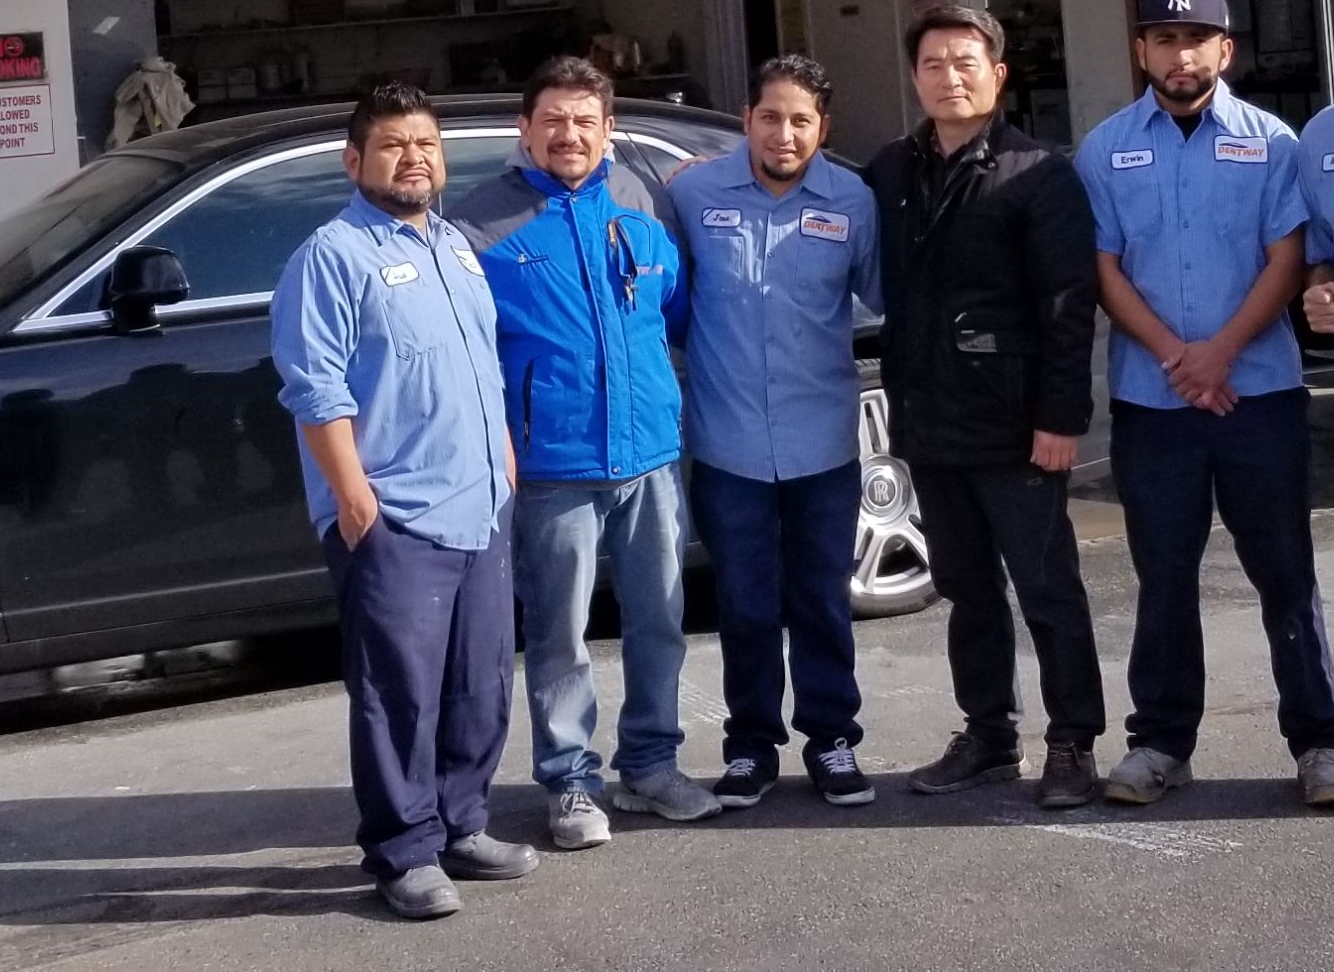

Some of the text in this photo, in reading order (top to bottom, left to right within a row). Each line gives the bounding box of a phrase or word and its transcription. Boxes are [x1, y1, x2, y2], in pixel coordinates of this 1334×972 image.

[19, 122, 39, 134] THIS
[0, 137, 26, 149] POINT
[1218, 146, 1265, 159] DENTWAY
[1121, 154, 1144, 164] Erwin
